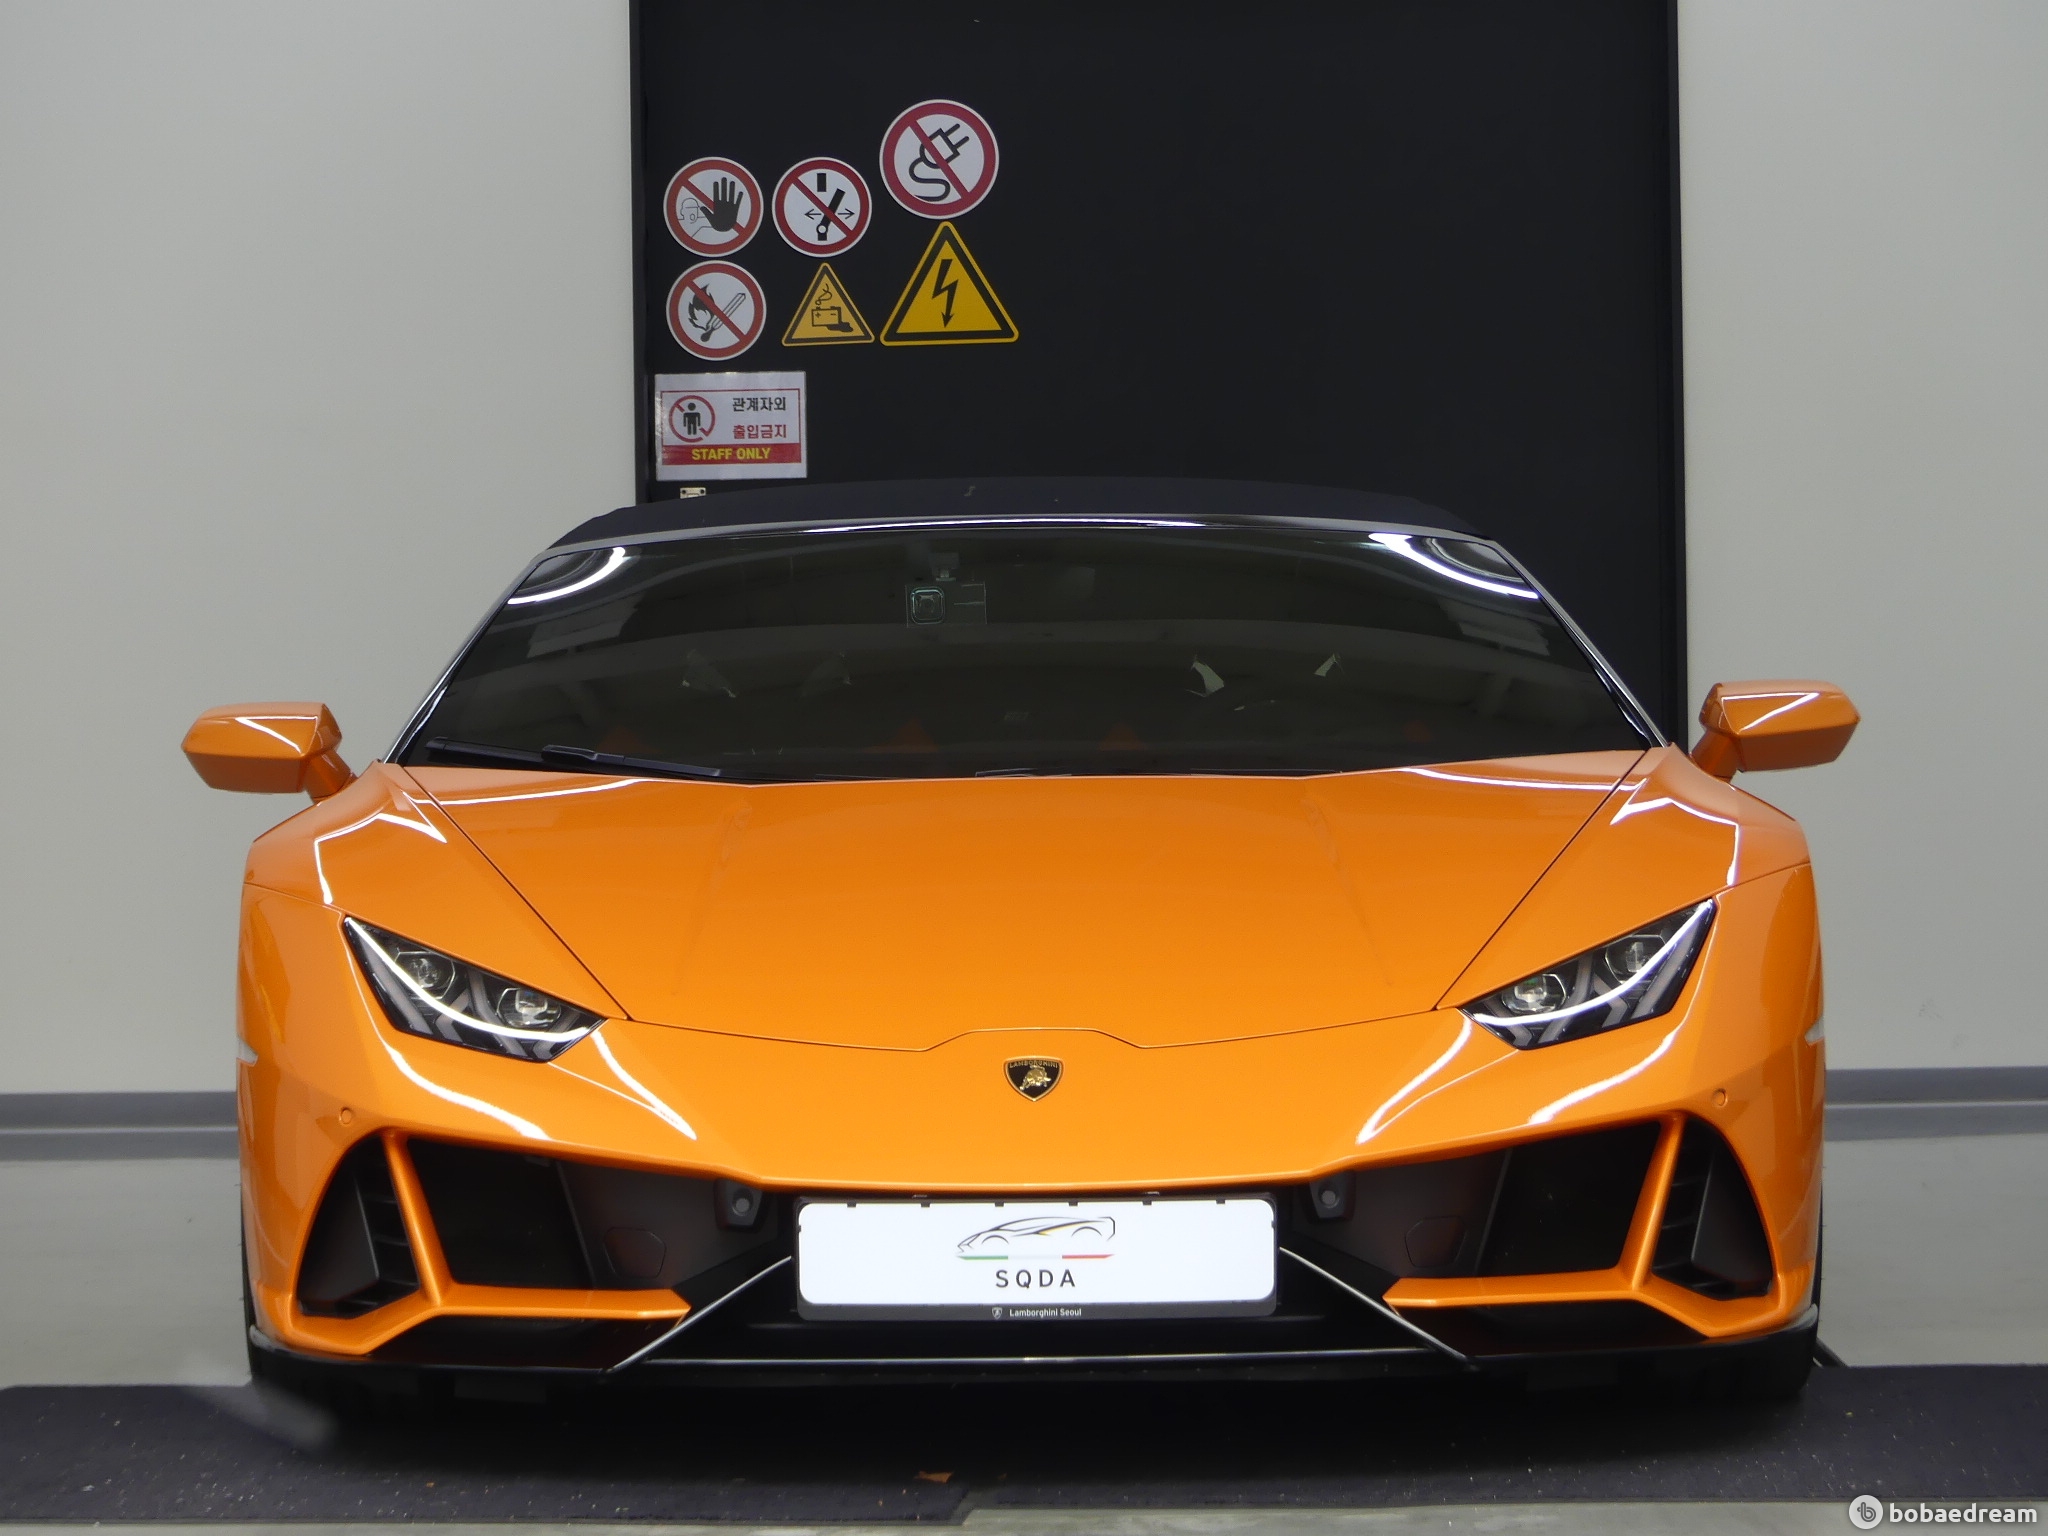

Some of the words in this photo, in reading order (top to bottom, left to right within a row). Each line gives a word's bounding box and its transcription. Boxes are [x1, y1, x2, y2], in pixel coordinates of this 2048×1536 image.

[732, 397, 786, 412] 관계자외
[732, 424, 787, 439] 출입금지
[692, 448, 732, 461] STAFF
[736, 447, 771, 460] ONLY
[995, 1269, 1076, 1289] SQDA
[1009, 1308, 1058, 1319] Lamborghini
[1060, 1308, 1082, 1317] Seoul
